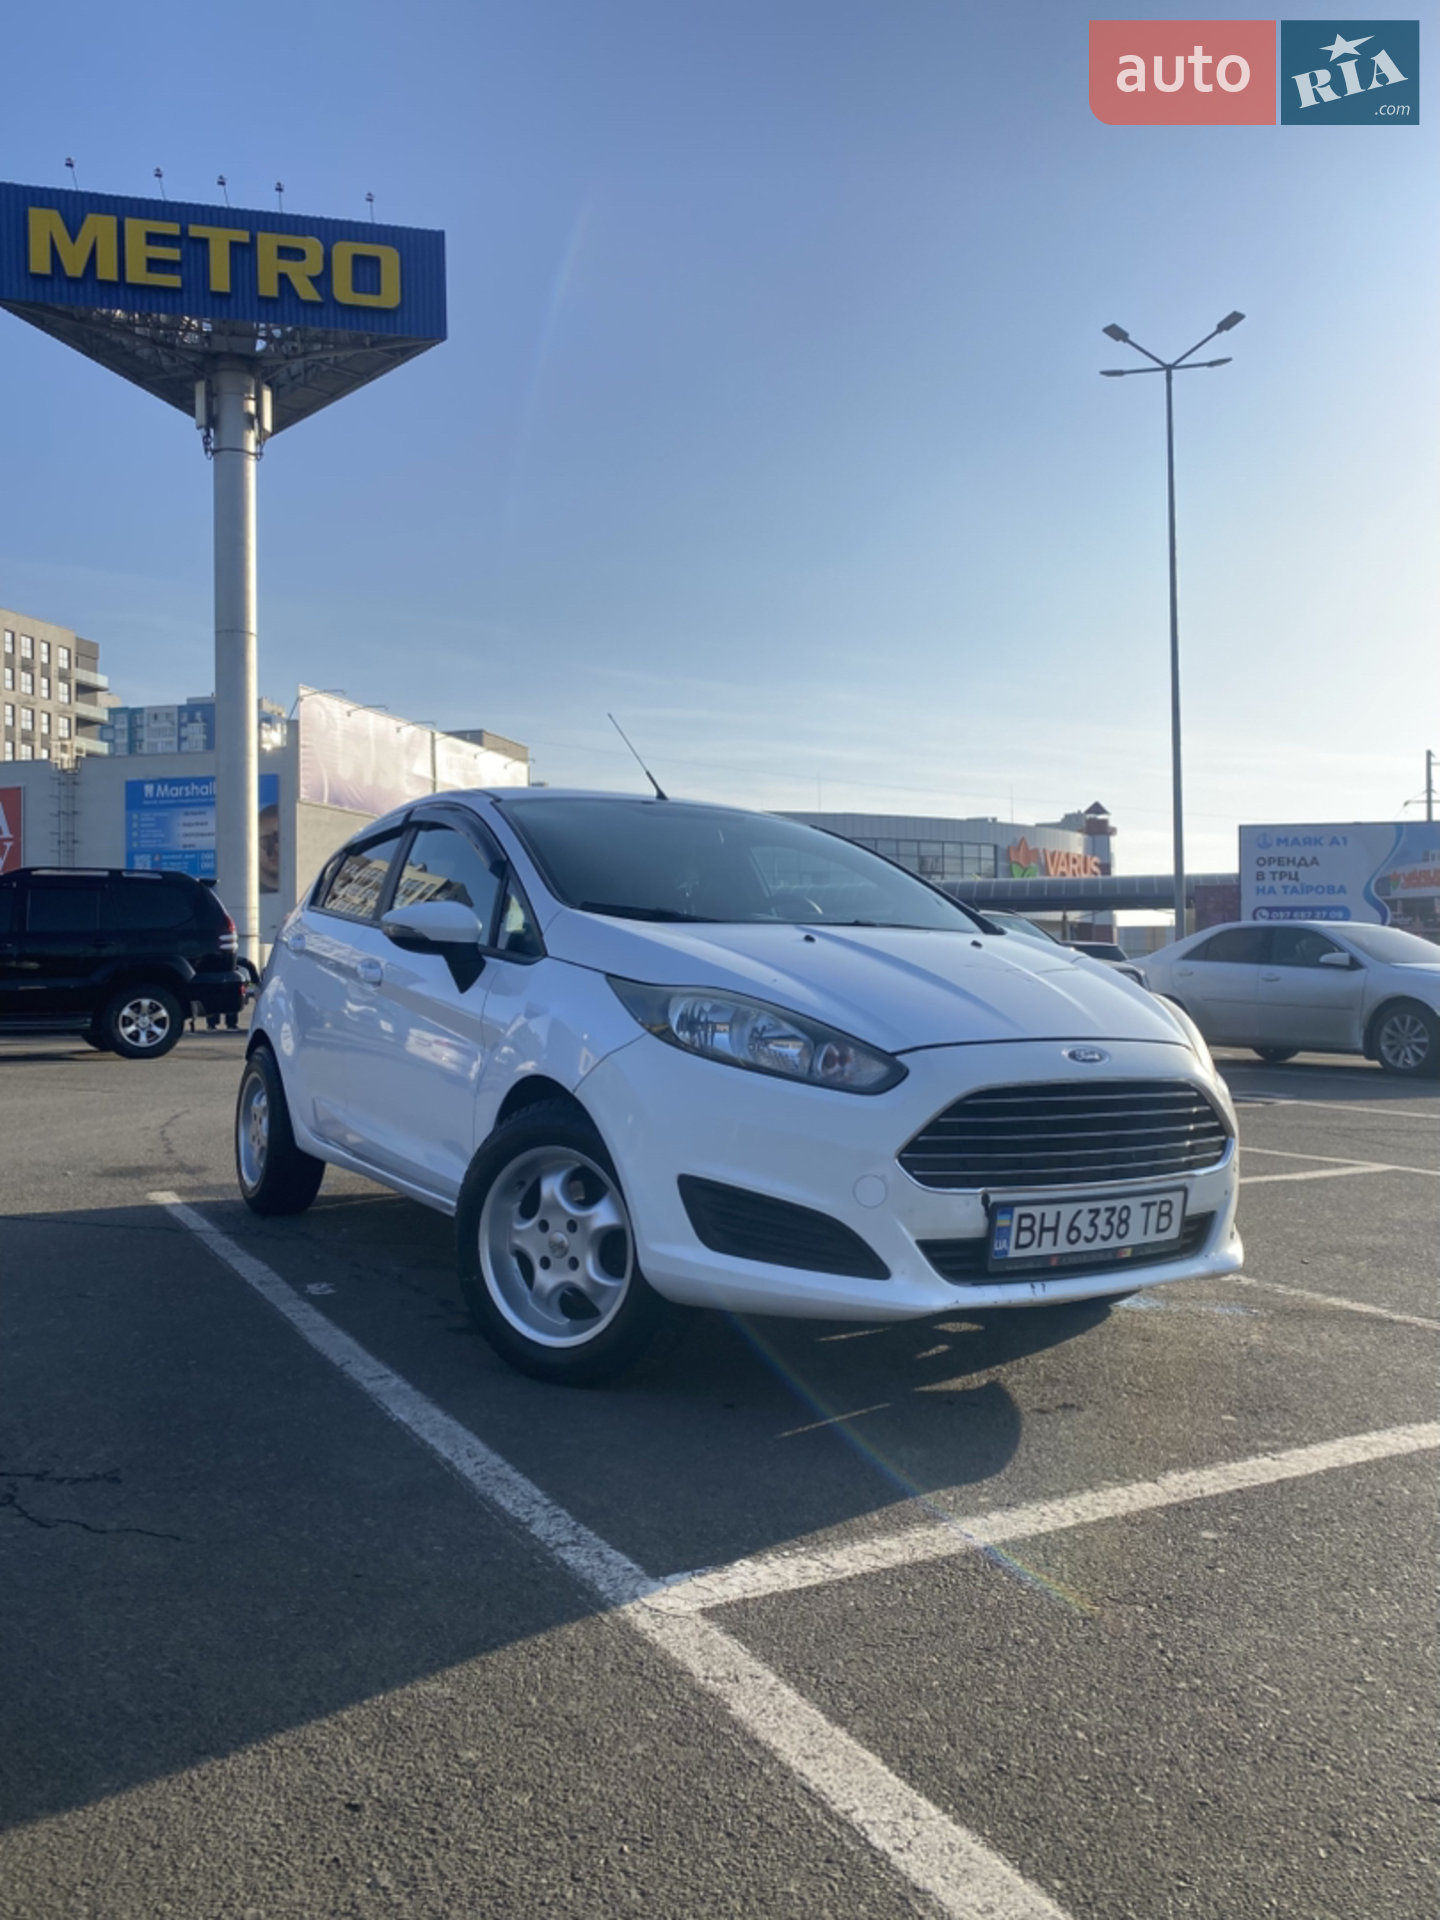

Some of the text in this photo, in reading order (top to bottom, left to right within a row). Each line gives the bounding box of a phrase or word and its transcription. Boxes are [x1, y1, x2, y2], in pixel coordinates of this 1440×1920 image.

[28, 206, 401, 310] METRO
[1275, 836, 1324, 847] МАЯК
[1043, 848, 1101, 877] VARUS
[1255, 856, 1320, 868] ОРЕНДА
[1256, 870, 1300, 882] В ТРЦ
[1256, 883, 1348, 896] НА ТАЇРОВА
[1014, 1198, 1174, 1250] BH 6338 TB
[994, 1239, 1009, 1250] UA
